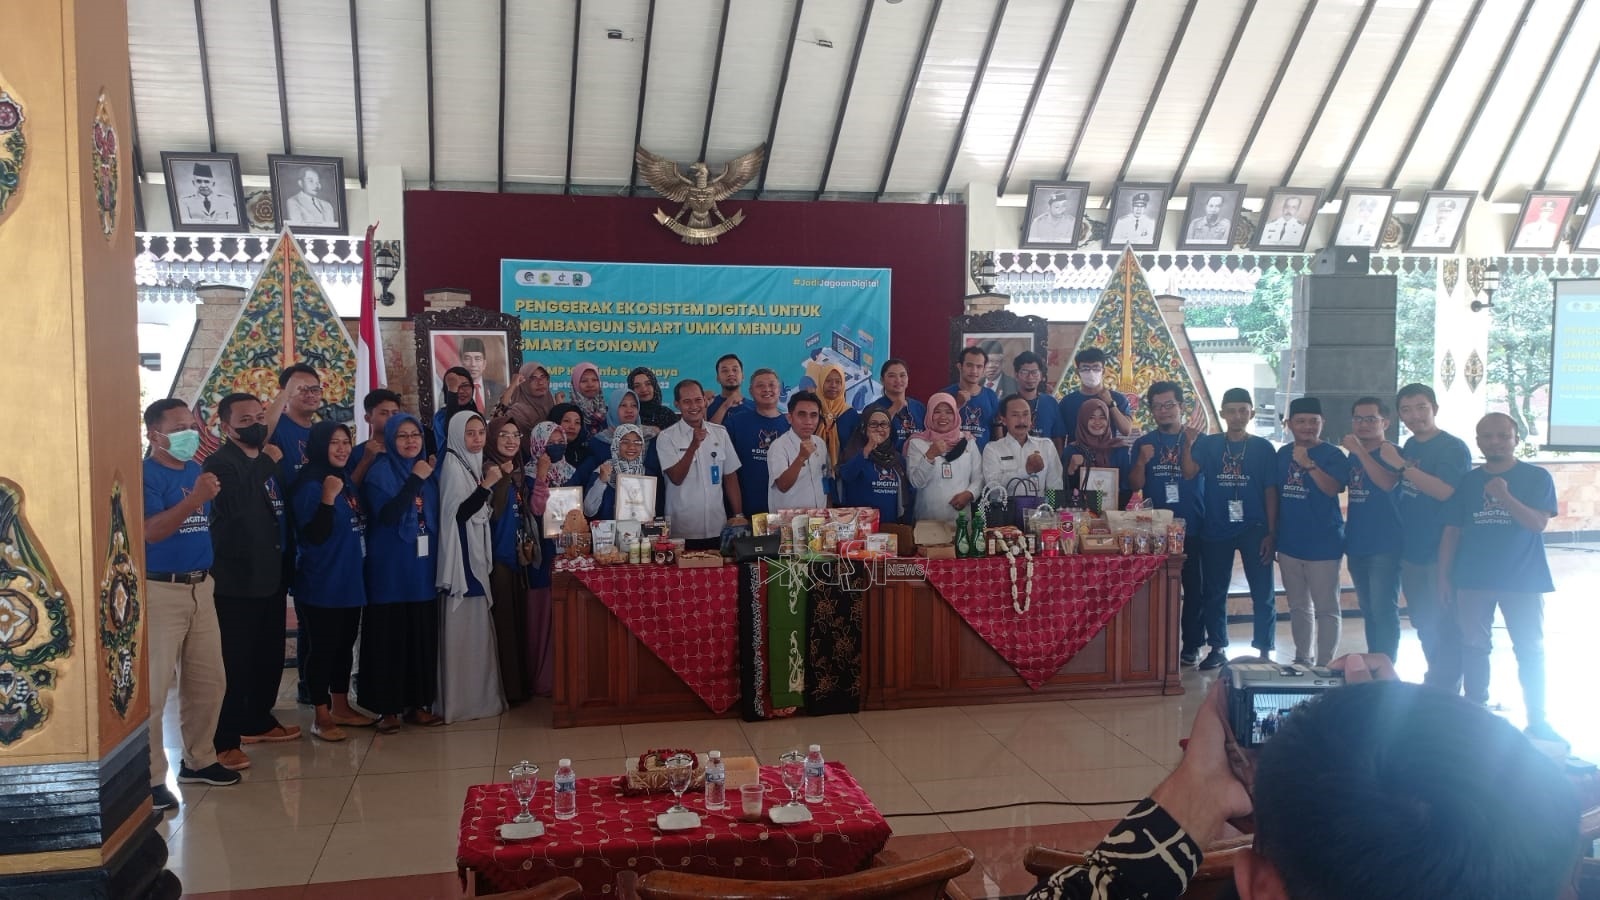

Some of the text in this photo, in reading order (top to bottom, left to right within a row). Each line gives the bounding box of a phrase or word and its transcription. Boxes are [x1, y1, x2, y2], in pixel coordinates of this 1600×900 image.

[793, 278, 879, 289] #JadiJagoanDigital
[515, 299, 822, 318] PENGGERAK EKOSISTEM DIGITAL UNTUK
[520, 319, 802, 336] MEMBANGUN SMART UMKM MENUJU
[575, 339, 659, 353] ECONOMY
